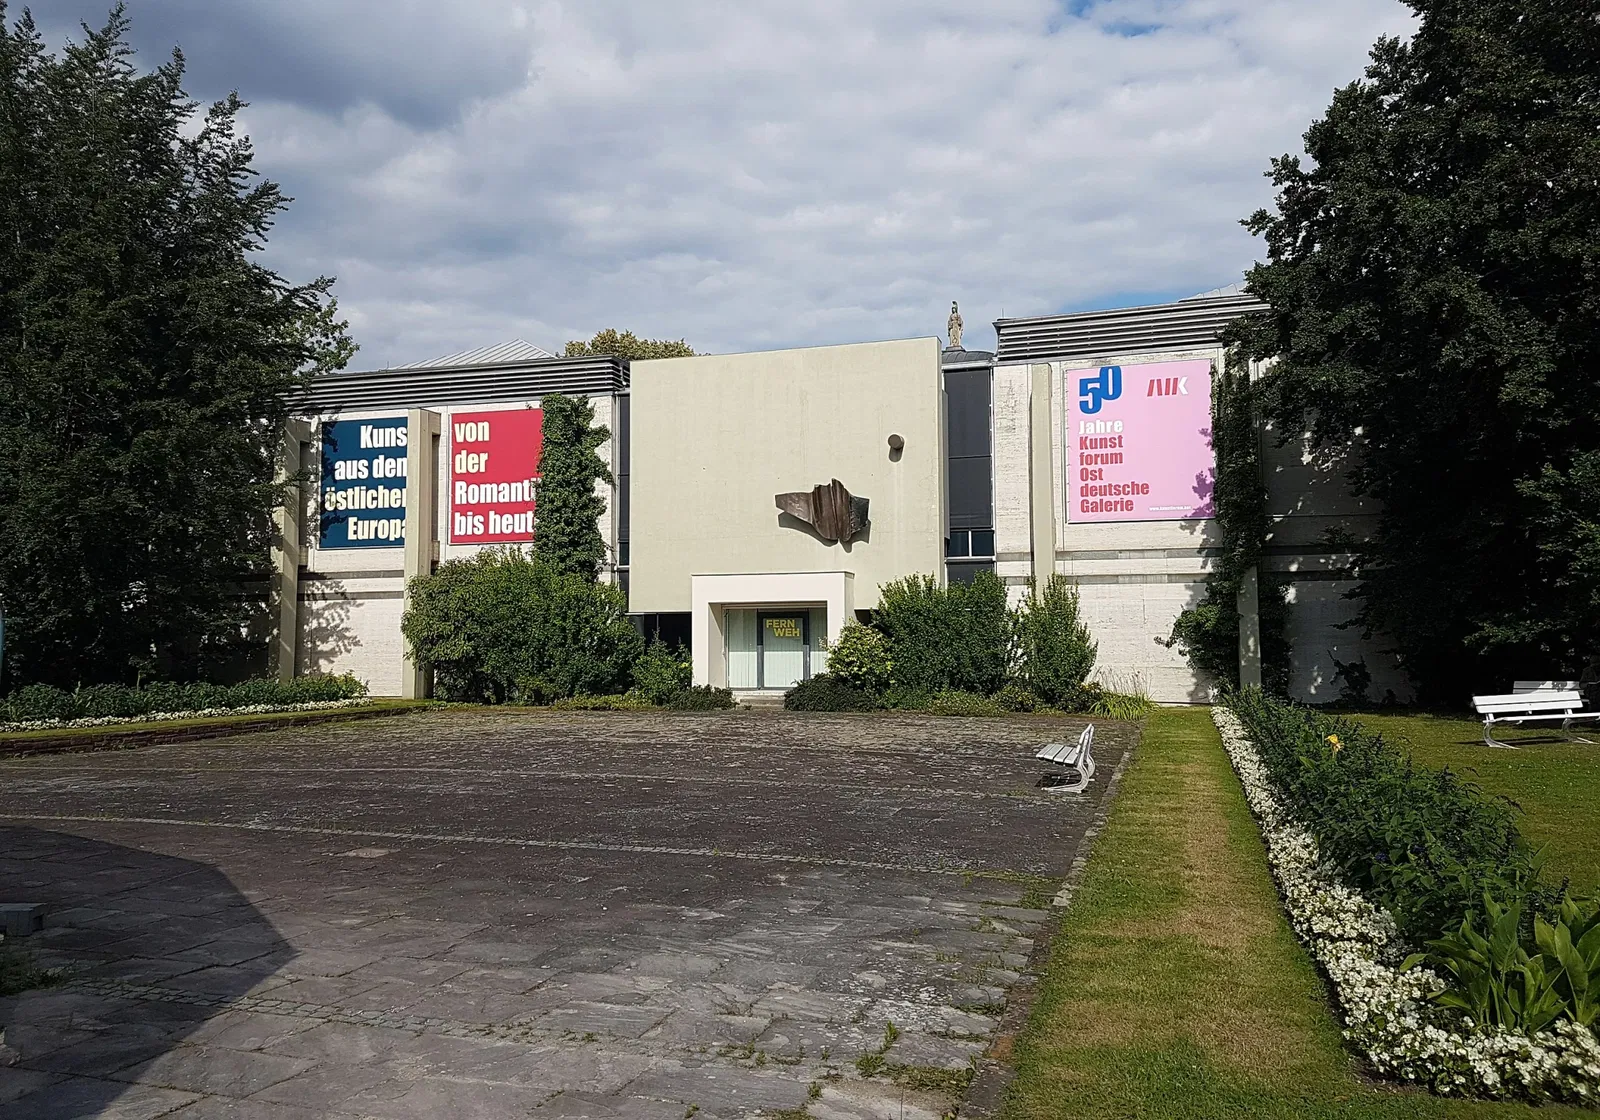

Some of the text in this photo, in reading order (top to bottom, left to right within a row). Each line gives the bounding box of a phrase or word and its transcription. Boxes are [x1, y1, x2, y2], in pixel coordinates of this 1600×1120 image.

[1079, 366, 1123, 415] 50
[454, 421, 490, 443] von
[1079, 420, 1123, 435] Jahre
[1079, 435, 1124, 450] Kunst
[454, 450, 489, 474] der
[1079, 452, 1124, 466] forum
[334, 455, 408, 480] aus den
[1080, 468, 1104, 482] Ost
[454, 478, 541, 505] Romanti
[1080, 481, 1150, 497] deutsche
[1080, 498, 1134, 513] Galerie
[454, 510, 538, 536] bis heut
[766, 619, 795, 628] FERN
[773, 628, 800, 637] WEH
